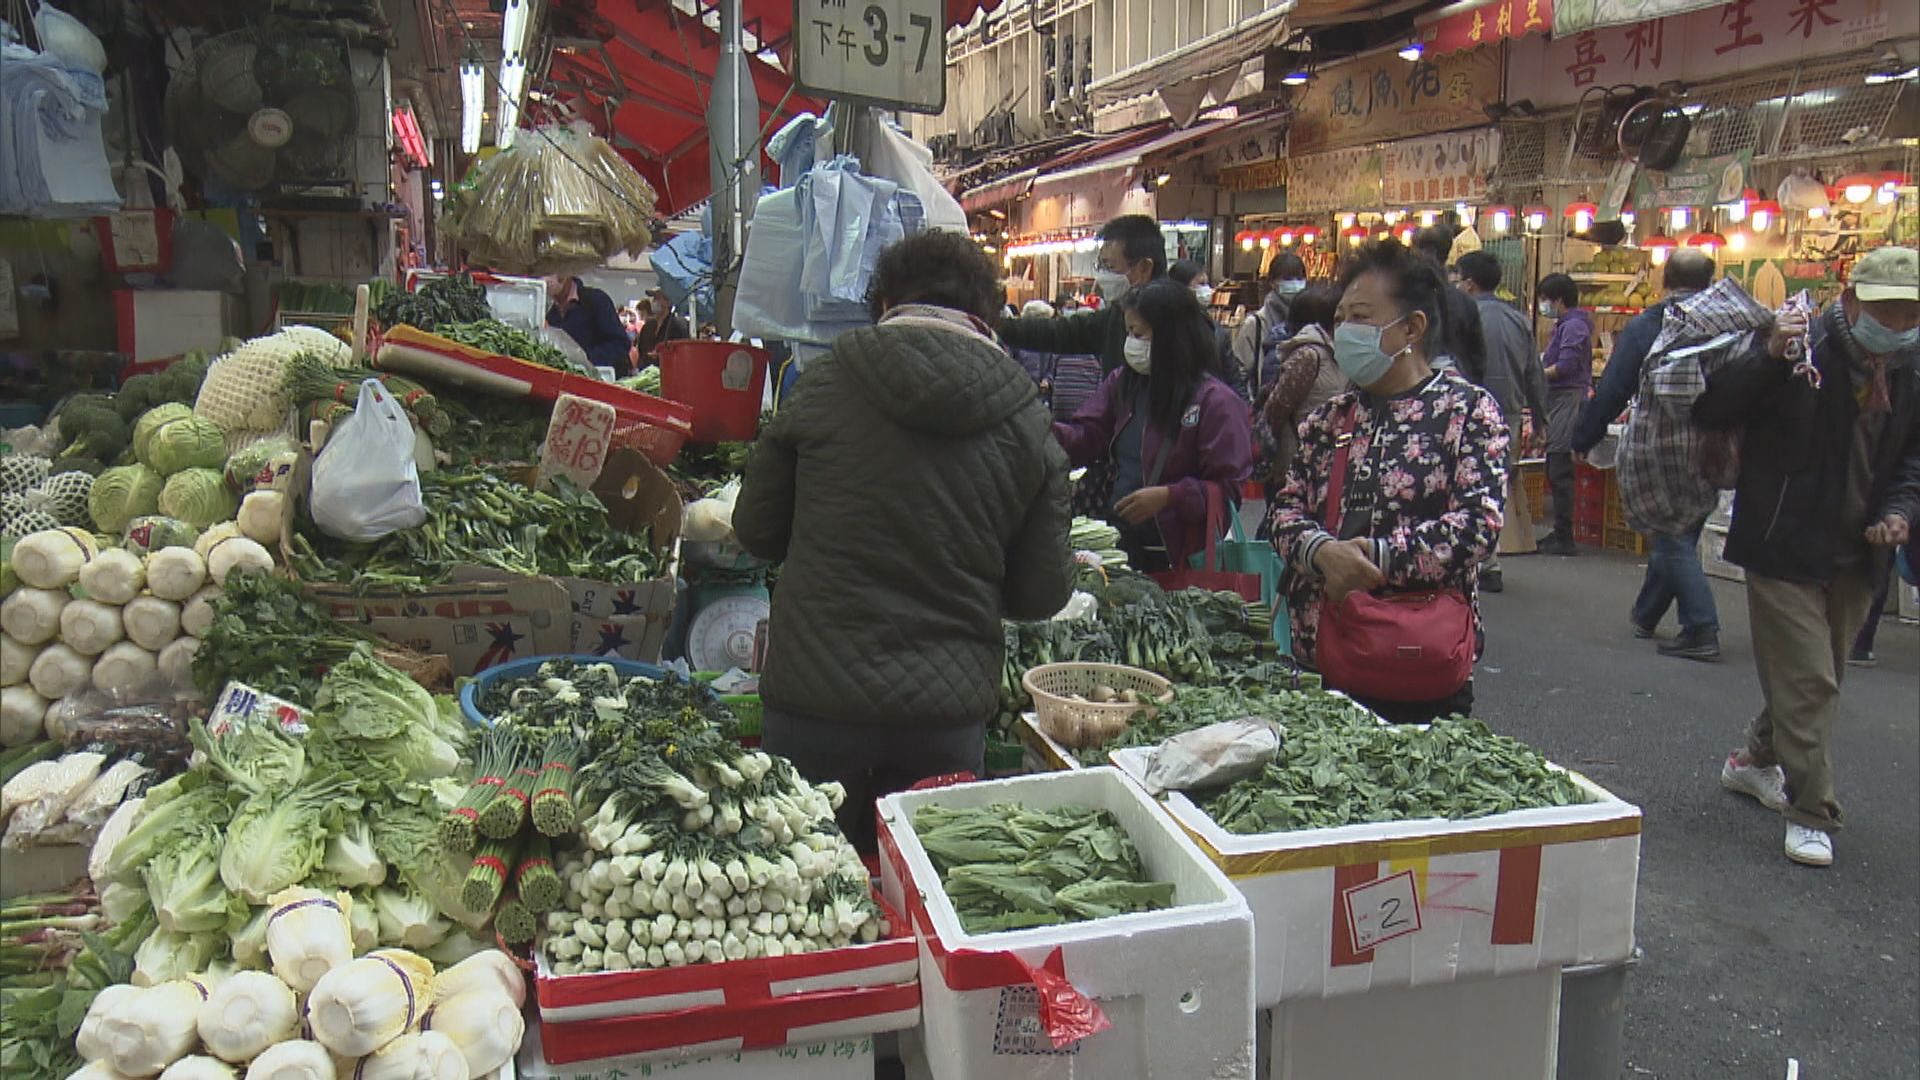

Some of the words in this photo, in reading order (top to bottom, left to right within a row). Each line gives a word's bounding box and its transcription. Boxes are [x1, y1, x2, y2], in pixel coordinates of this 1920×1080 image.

[812, 20, 857, 62] 下午
[863, 5, 932, 73] 3-7
[1380, 898, 1409, 929] 2
